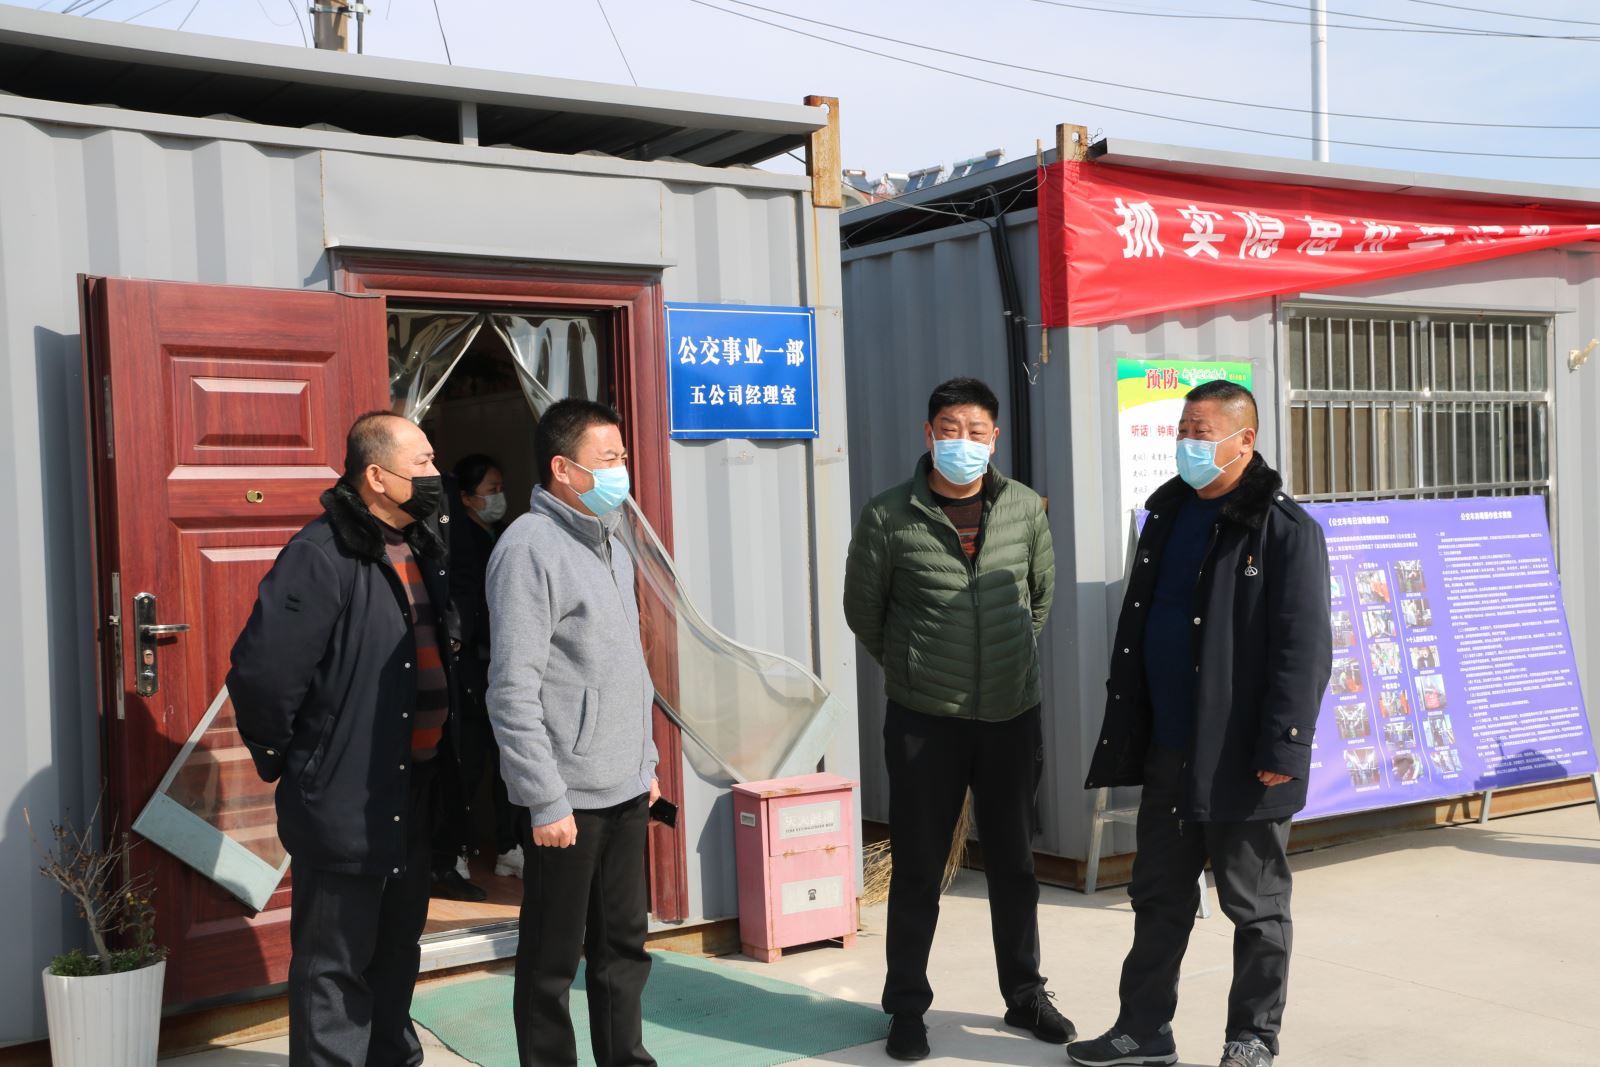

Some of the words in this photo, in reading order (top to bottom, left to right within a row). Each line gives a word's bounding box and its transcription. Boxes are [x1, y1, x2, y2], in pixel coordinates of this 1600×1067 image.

[677, 335, 805, 367] 公交事业一部
[1144, 368, 1179, 390] 预防
[689, 384, 797, 406] 五公司经理室
